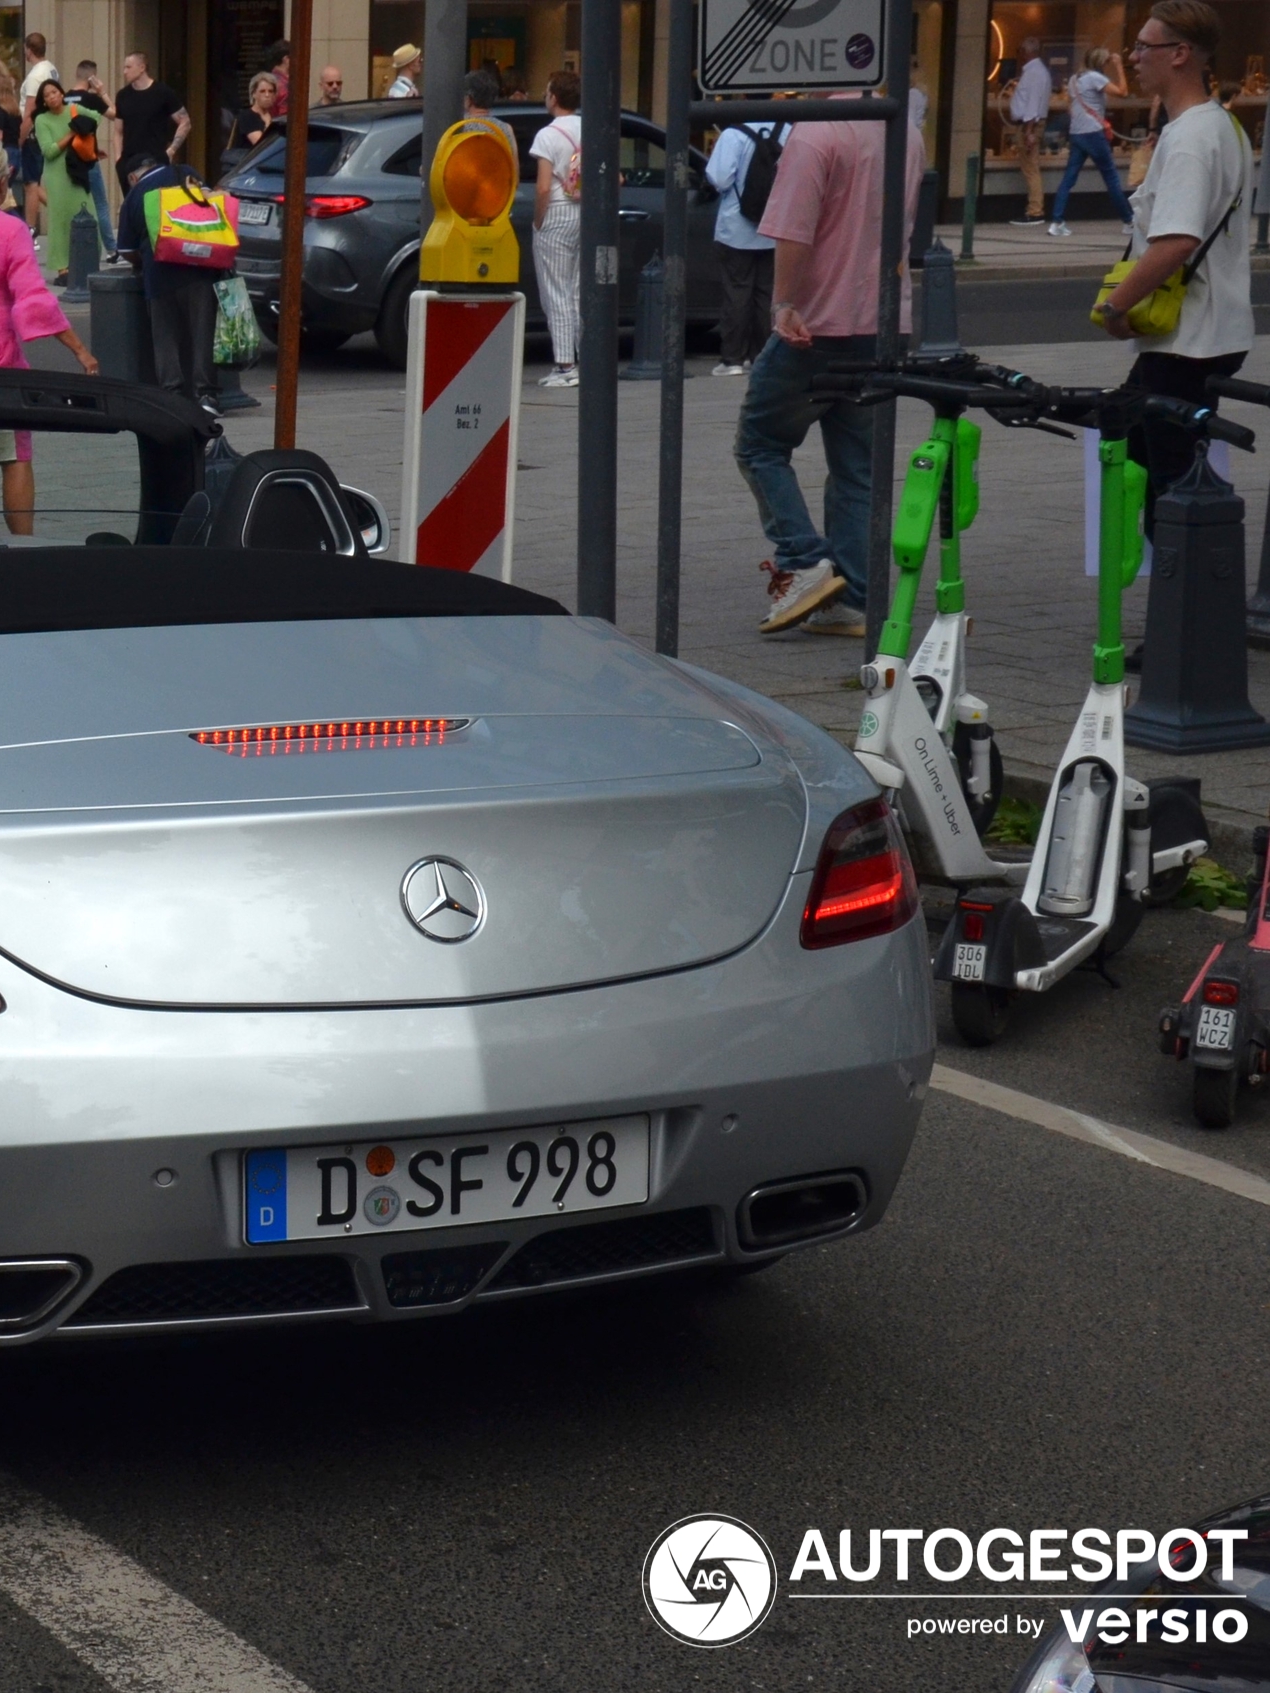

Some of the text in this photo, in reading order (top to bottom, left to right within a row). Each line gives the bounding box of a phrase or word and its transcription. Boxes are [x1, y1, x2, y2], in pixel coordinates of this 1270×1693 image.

[748, 38, 838, 73] ZONE
[473, 404, 481, 415] 66
[456, 418, 479, 429] Bez. 2
[914, 737, 929, 761] On
[924, 759, 943, 793] Lime
[943, 802, 961, 836] Uber
[957, 946, 982, 962] 306
[956, 963, 980, 979] IDL
[1202, 1009, 1230, 1028] 161
[1199, 1027, 1228, 1046] WCZ
[316, 1156, 357, 1226] D
[405, 1144, 490, 1218] SF
[506, 1130, 617, 1208] 998
[260, 1206, 274, 1227] D
